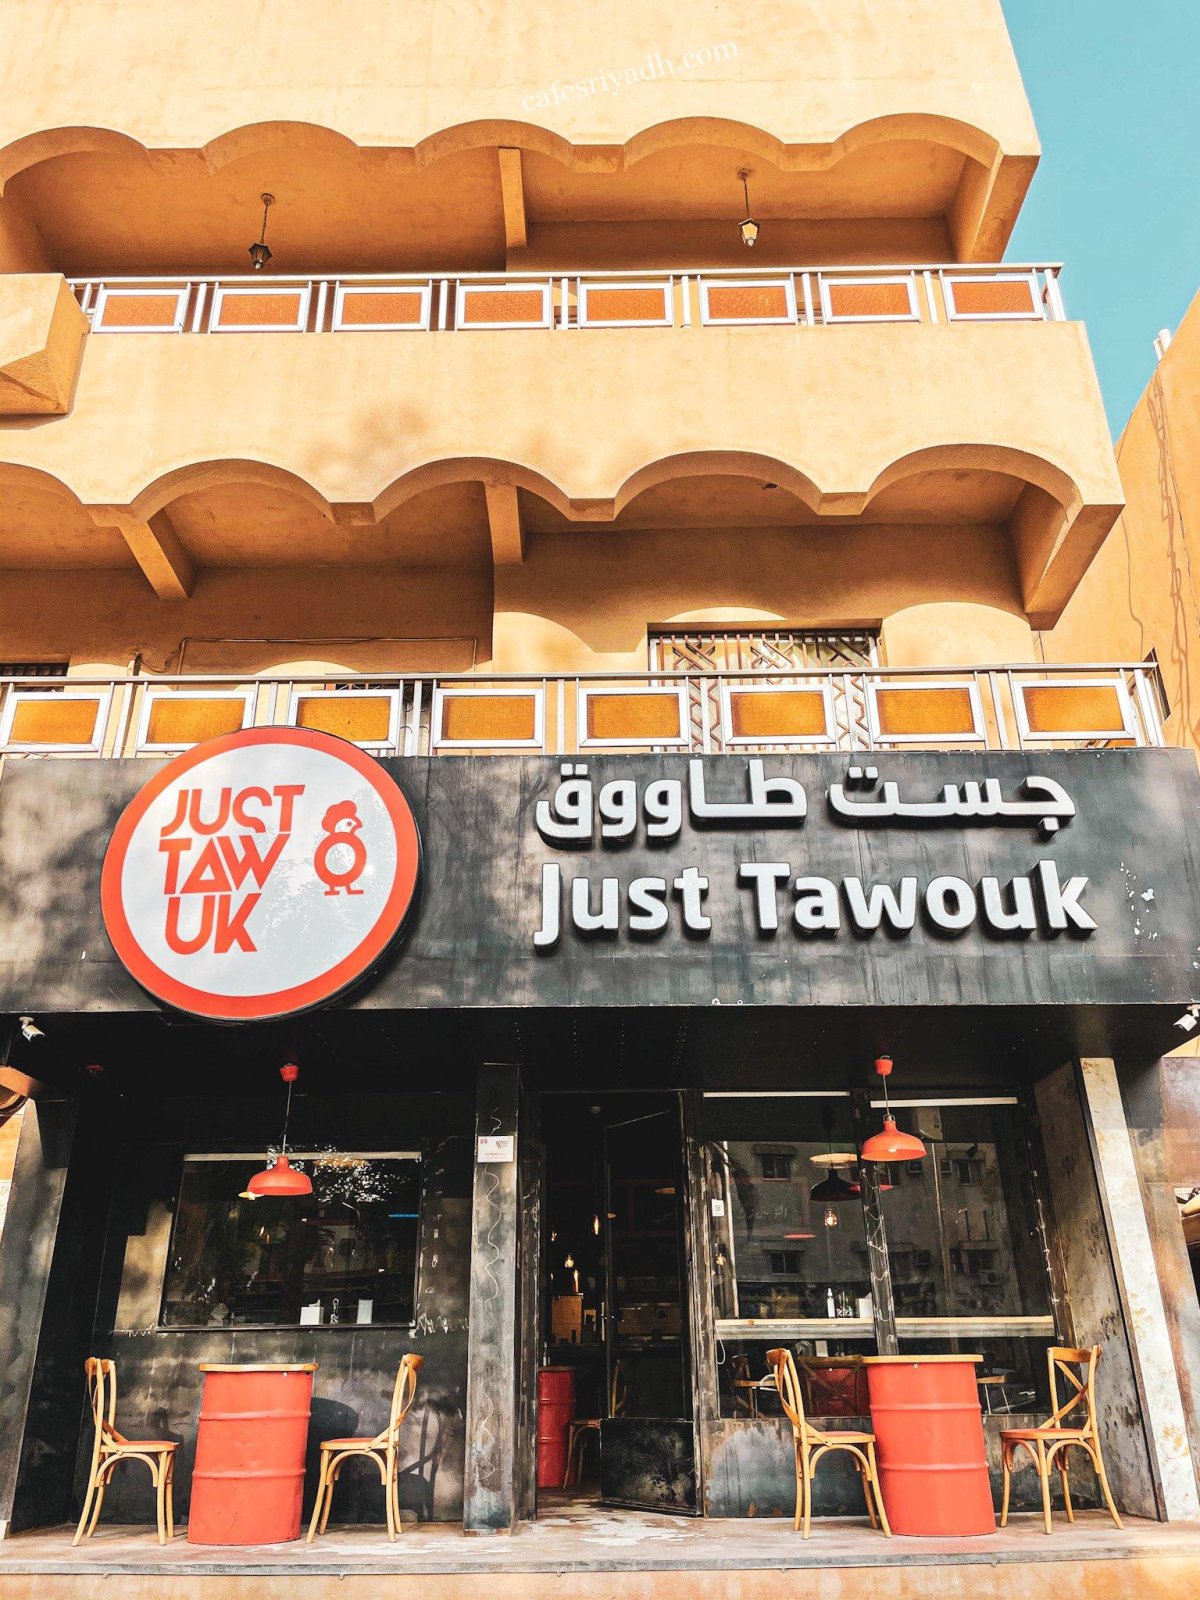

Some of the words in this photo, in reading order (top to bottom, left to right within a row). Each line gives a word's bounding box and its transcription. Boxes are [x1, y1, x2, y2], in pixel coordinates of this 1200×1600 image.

[160, 784, 306, 838] JUST
[535, 759, 808, 840] طاووق
[828, 766, 1077, 836] جست
[158, 833, 291, 895] TAW
[164, 893, 263, 955] UK
[533, 862, 712, 948] Just
[739, 859, 1098, 934] Tawouk
